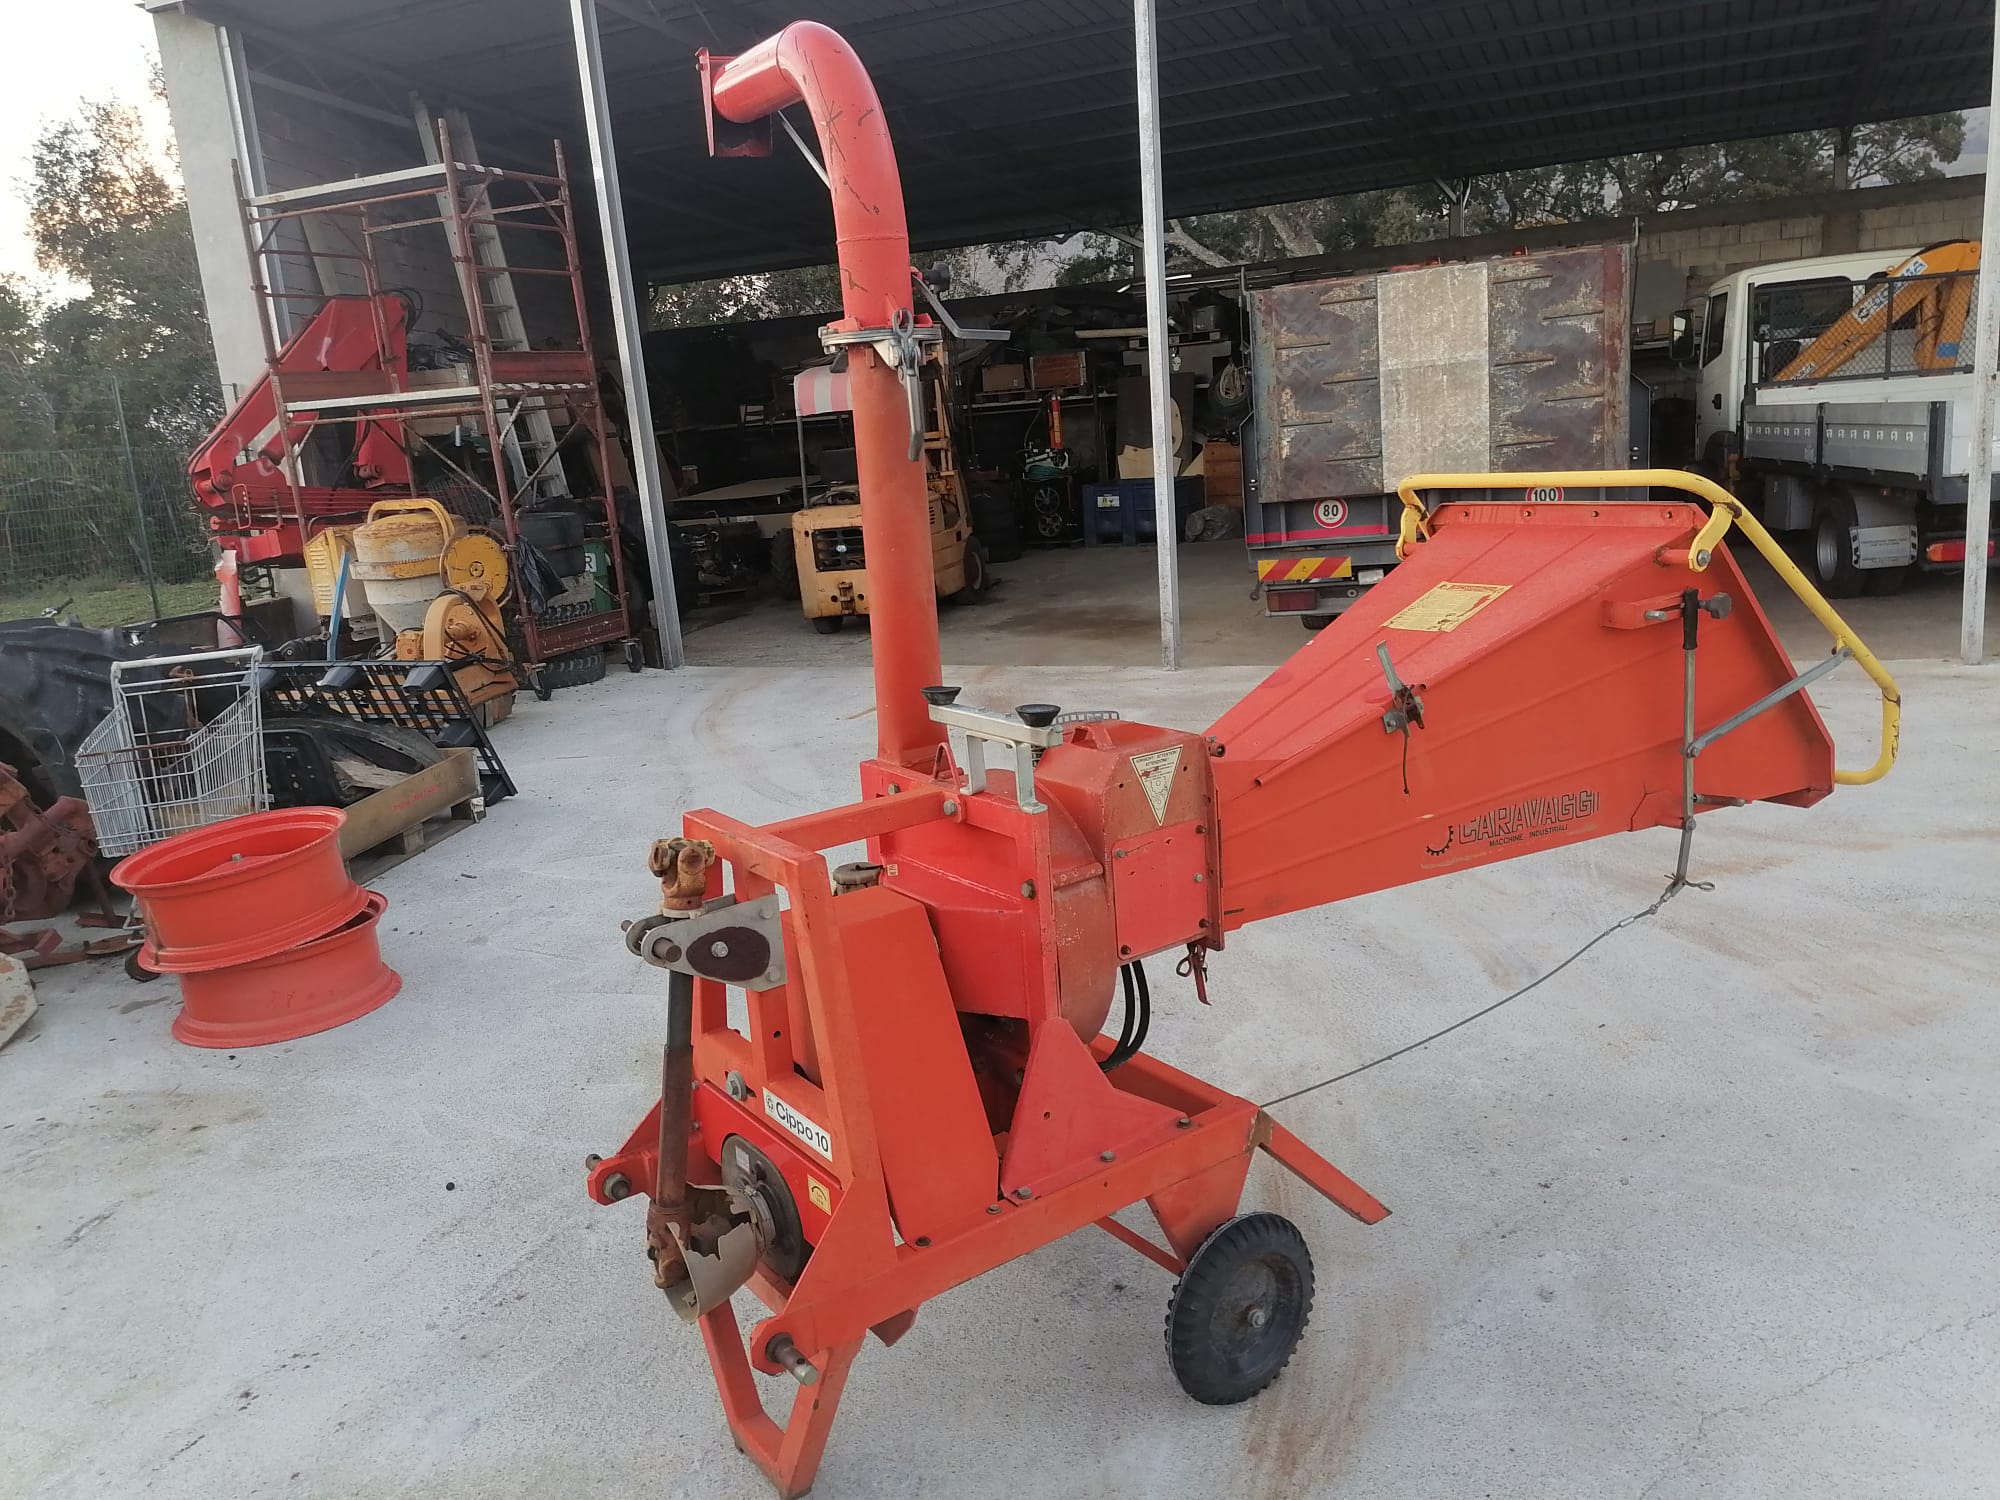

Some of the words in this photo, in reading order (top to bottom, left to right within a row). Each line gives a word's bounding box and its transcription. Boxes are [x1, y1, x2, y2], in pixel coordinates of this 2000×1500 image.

[1533, 488, 1557, 501] 100
[1323, 504, 1339, 517] 80
[1489, 834, 1524, 847] MACCHINE
[1529, 824, 1568, 838] INDUSTRIALI
[776, 1101, 813, 1141] Cippo
[815, 1131, 829, 1153] 10
